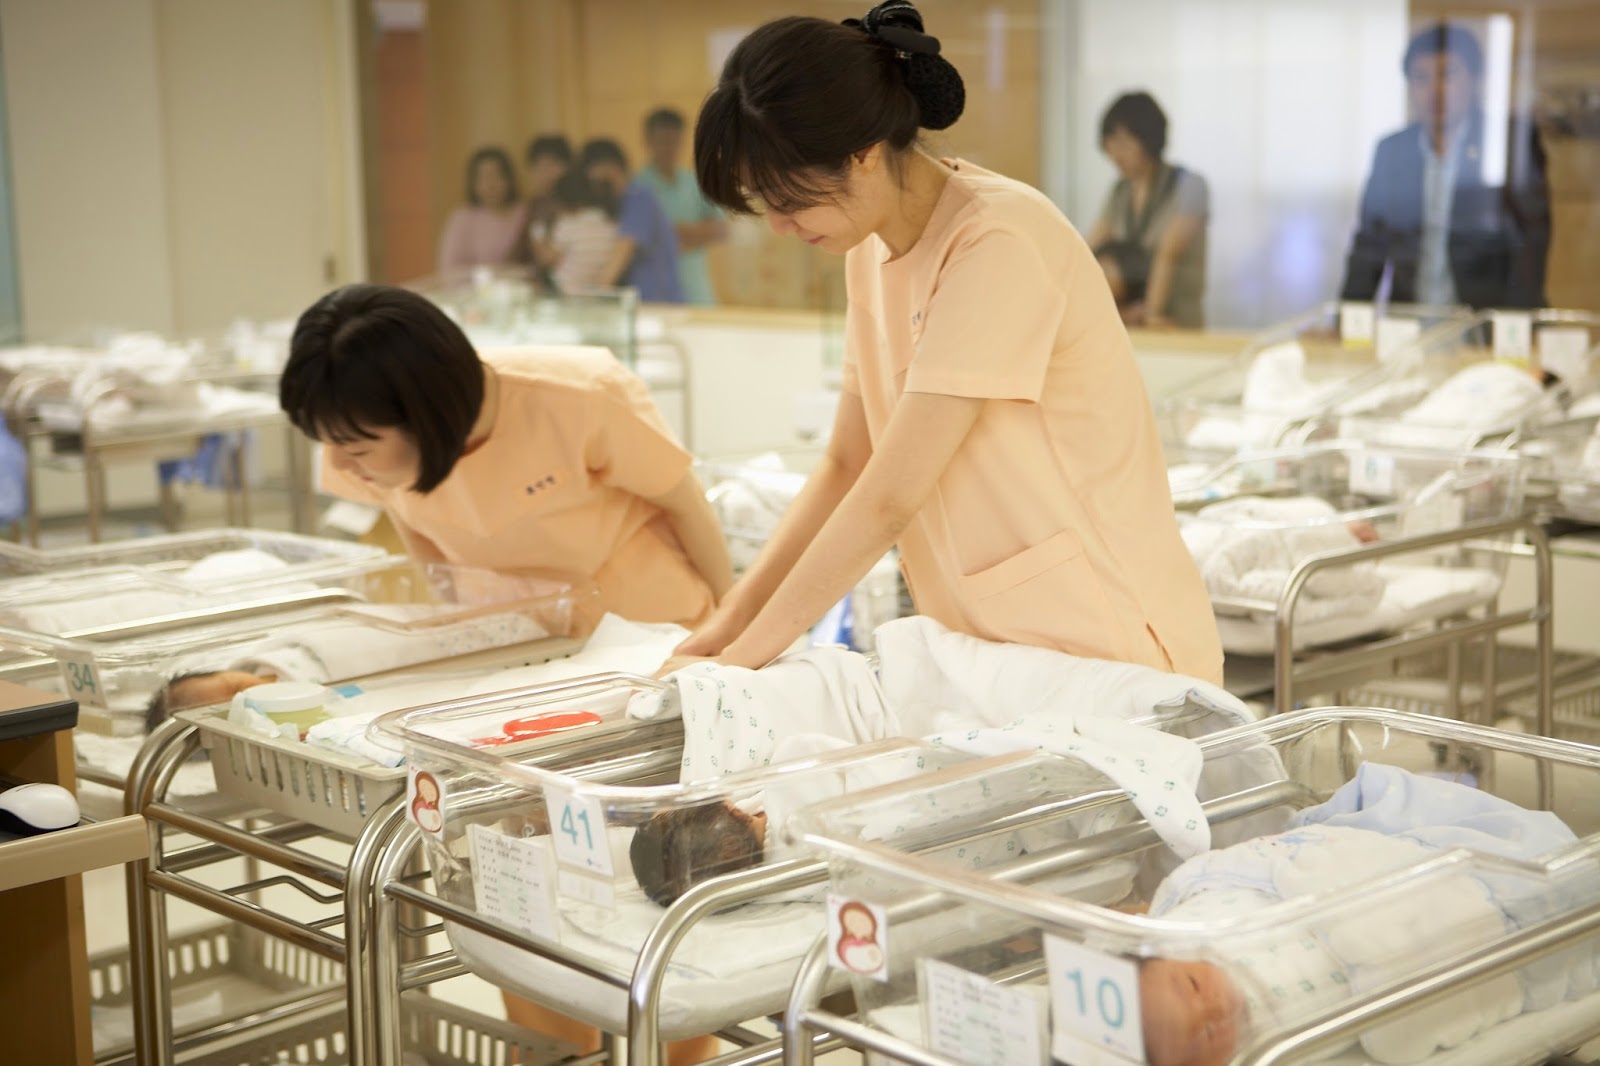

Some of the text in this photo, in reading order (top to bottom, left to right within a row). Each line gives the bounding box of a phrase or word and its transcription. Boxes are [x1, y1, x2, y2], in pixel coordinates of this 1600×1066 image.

[67, 661, 96, 694] 34
[560, 802, 594, 851] 41
[1066, 966, 1125, 1031] 10
